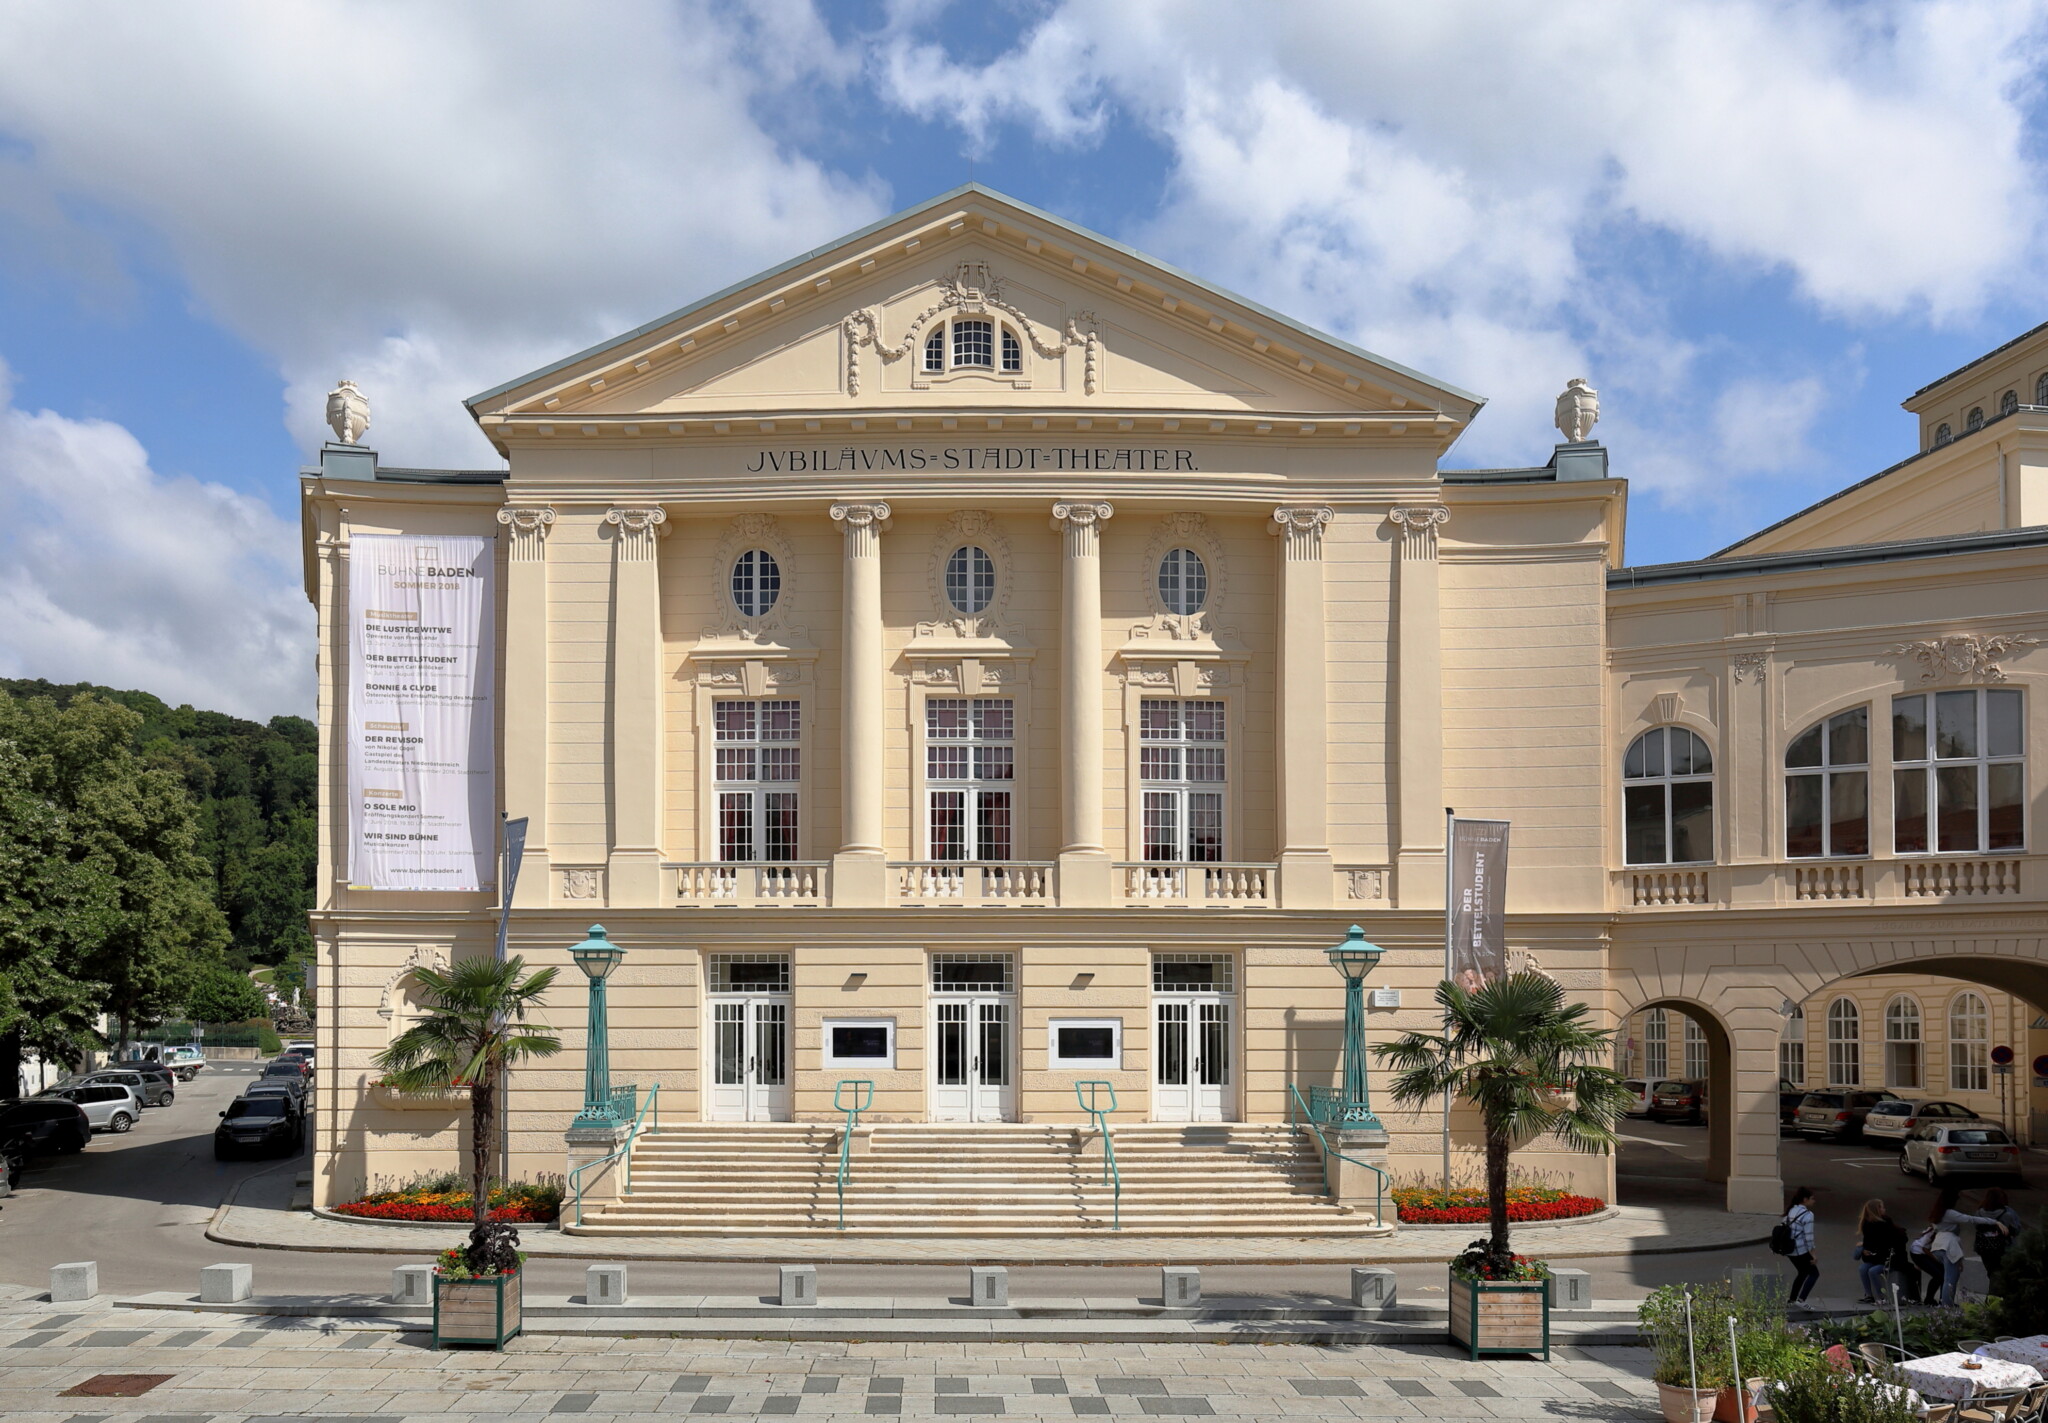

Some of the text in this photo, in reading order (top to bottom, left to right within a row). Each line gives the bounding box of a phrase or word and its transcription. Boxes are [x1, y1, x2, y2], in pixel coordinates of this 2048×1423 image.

[393, 581, 461, 590] SOMMER 2018
[366, 624, 381, 632] DIE
[383, 625, 420, 633] LUSTIGE
[366, 653, 458, 664] DER BETTELSTUDENT
[365, 683, 400, 692] BONNIE
[409, 684, 437, 692] CLYDE
[385, 736, 424, 744] REVISOR
[373, 803, 397, 811] SOLE
[398, 804, 416, 812] MIO
[364, 832, 383, 840] WIR
[408, 832, 439, 841] BÜHNE
[1463, 888, 1473, 912] DER
[1473, 851, 1485, 947] BETTELSTUDENT
